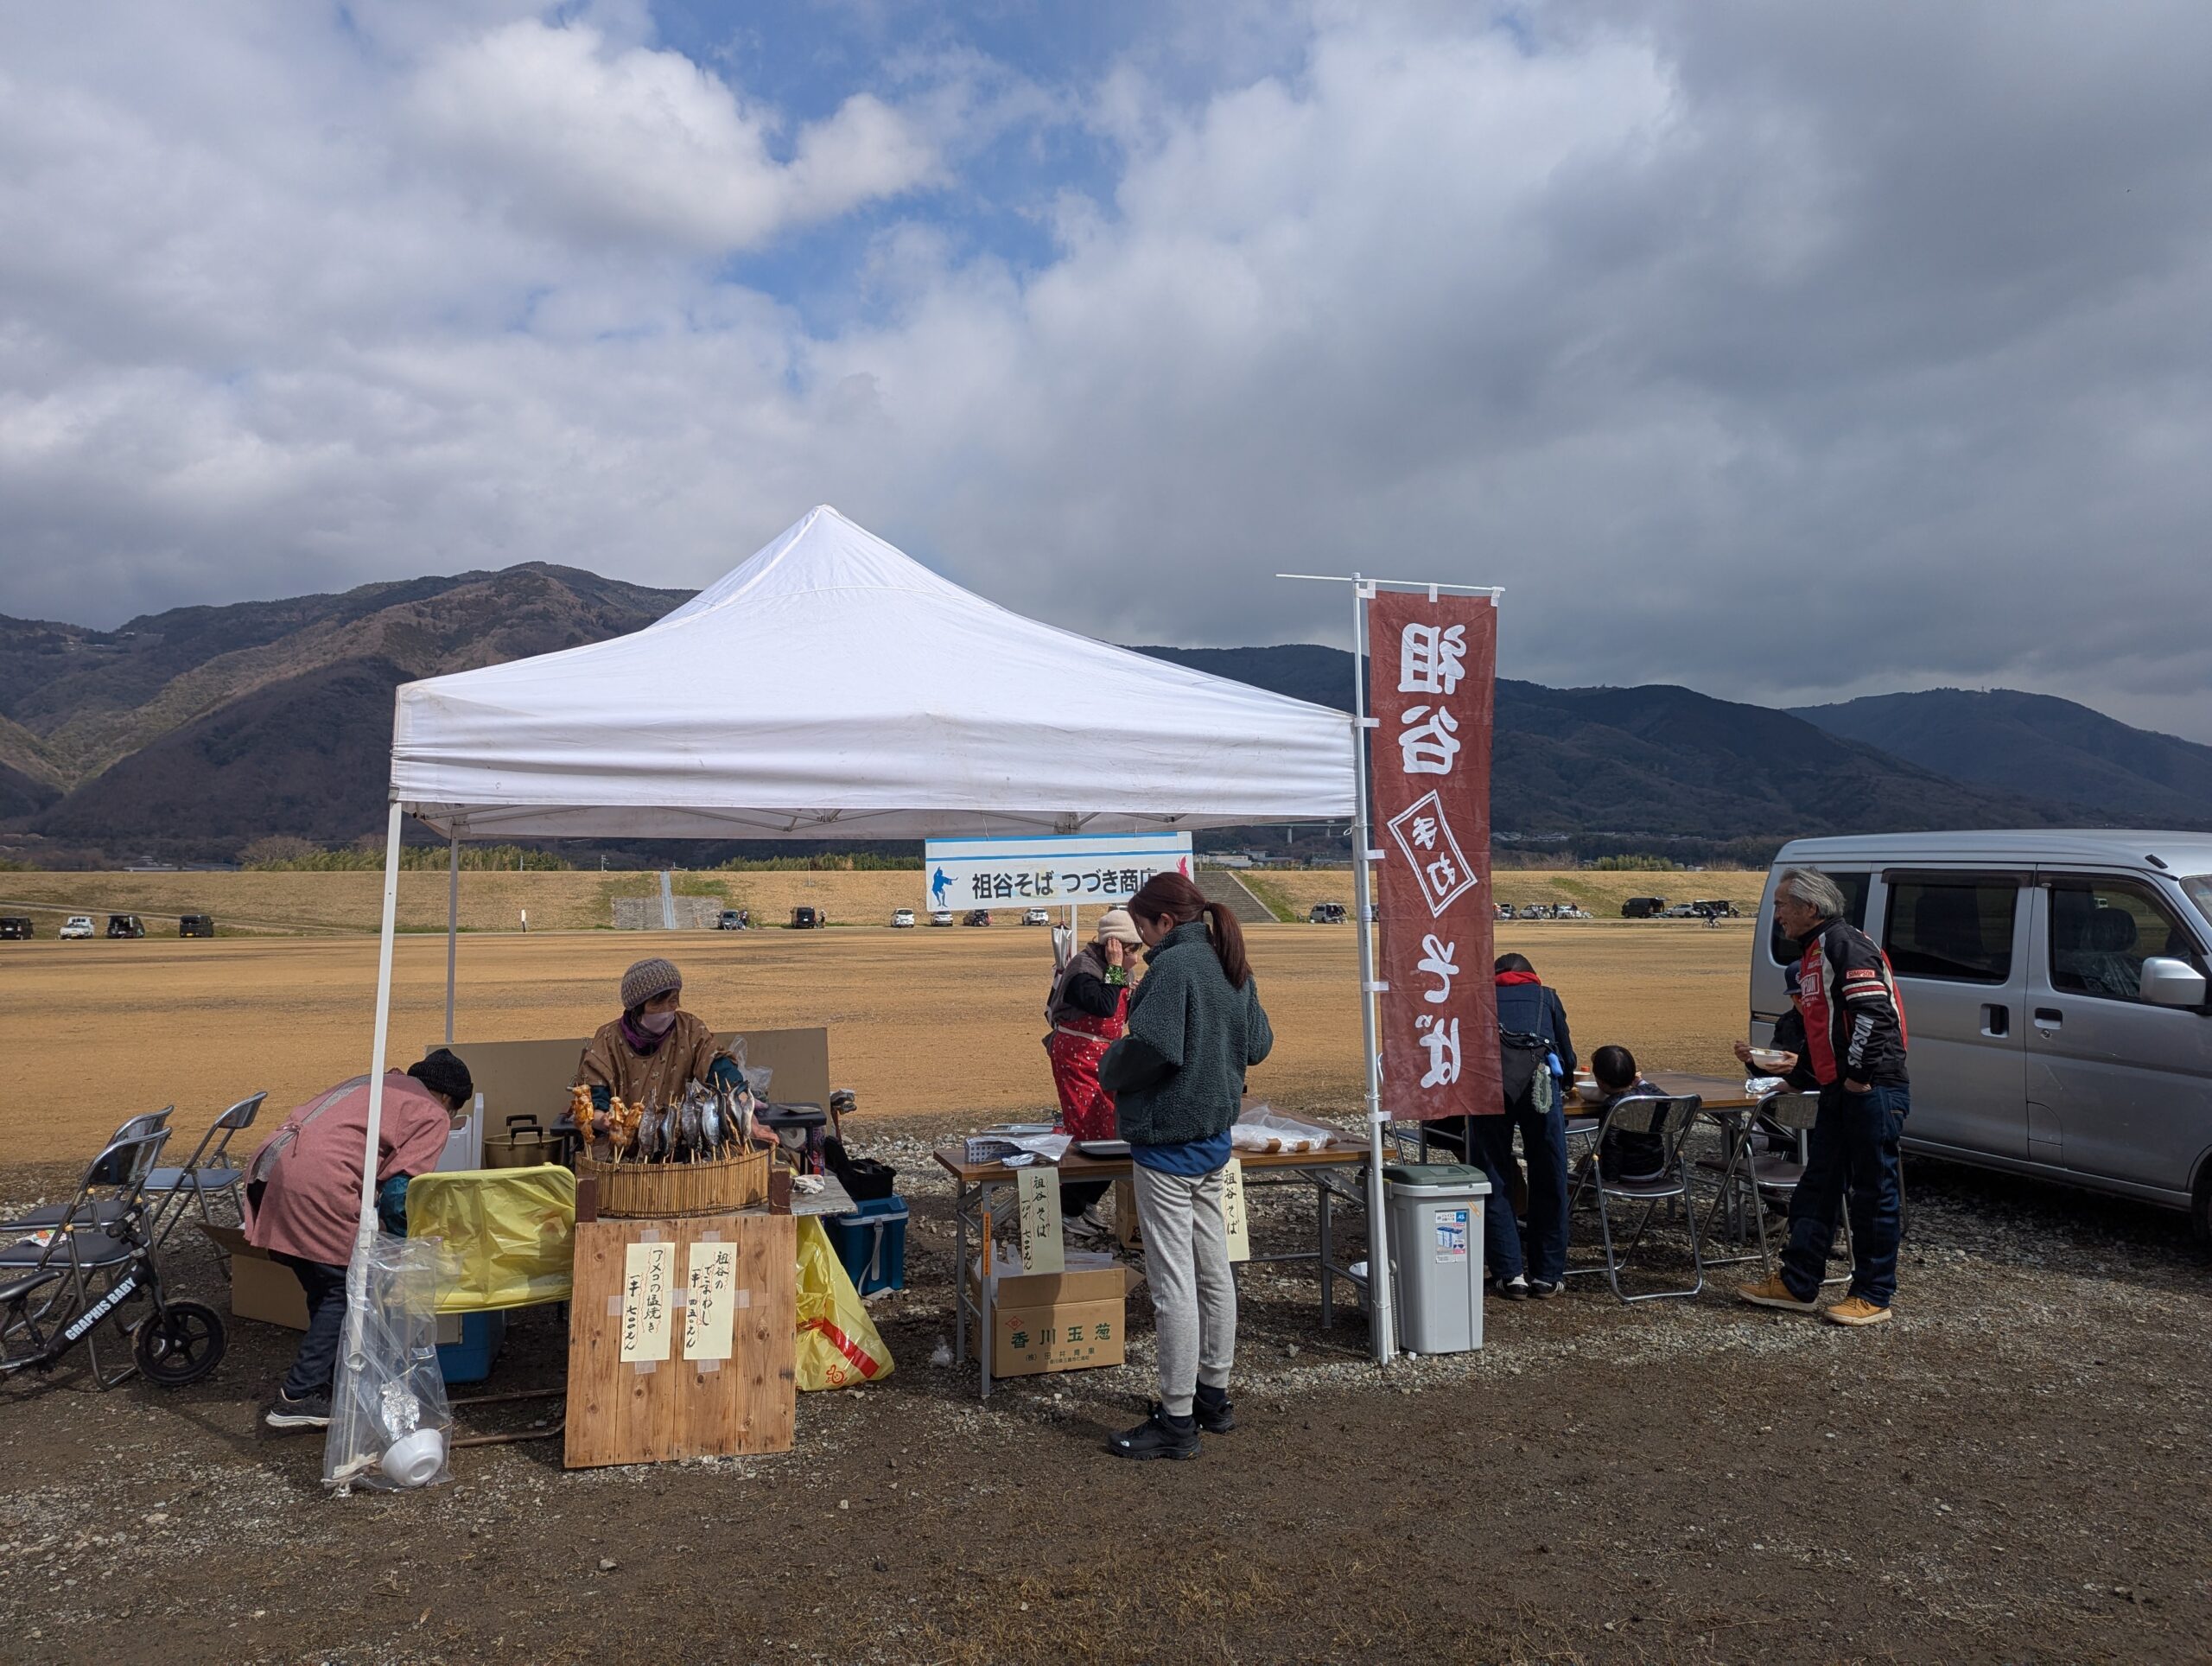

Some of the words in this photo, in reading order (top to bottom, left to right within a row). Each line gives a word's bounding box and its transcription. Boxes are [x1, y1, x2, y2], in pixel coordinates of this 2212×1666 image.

[972, 870, 1054, 900] 祖谷そば
[1847, 1014, 1875, 1069] SIMPSON
[65, 1300, 111, 1340] GRAPHIS
[107, 1276, 137, 1305] BABY
